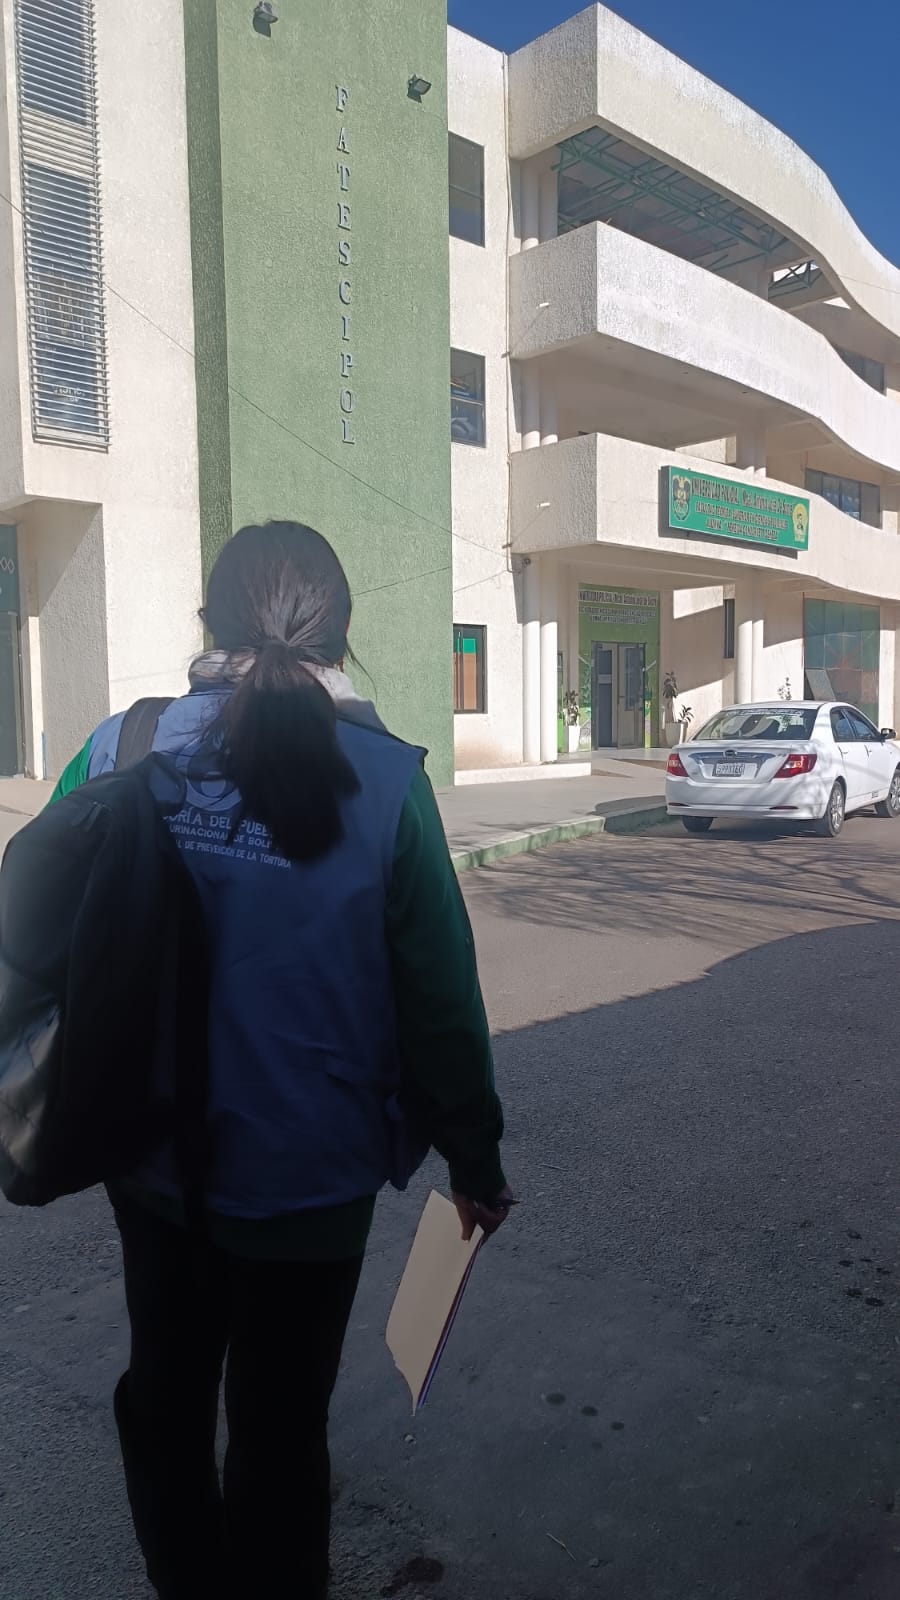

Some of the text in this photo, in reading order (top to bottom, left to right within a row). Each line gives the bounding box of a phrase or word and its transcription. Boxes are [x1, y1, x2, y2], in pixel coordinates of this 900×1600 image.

[335, 84, 356, 446] FATESCIPOL
[162, 806, 203, 826] ORÍA
[209, 815, 232, 830] DEL
[248, 836, 273, 849] BOLI
[246, 851, 257, 861] LA
[259, 853, 292, 869] TORTURA
